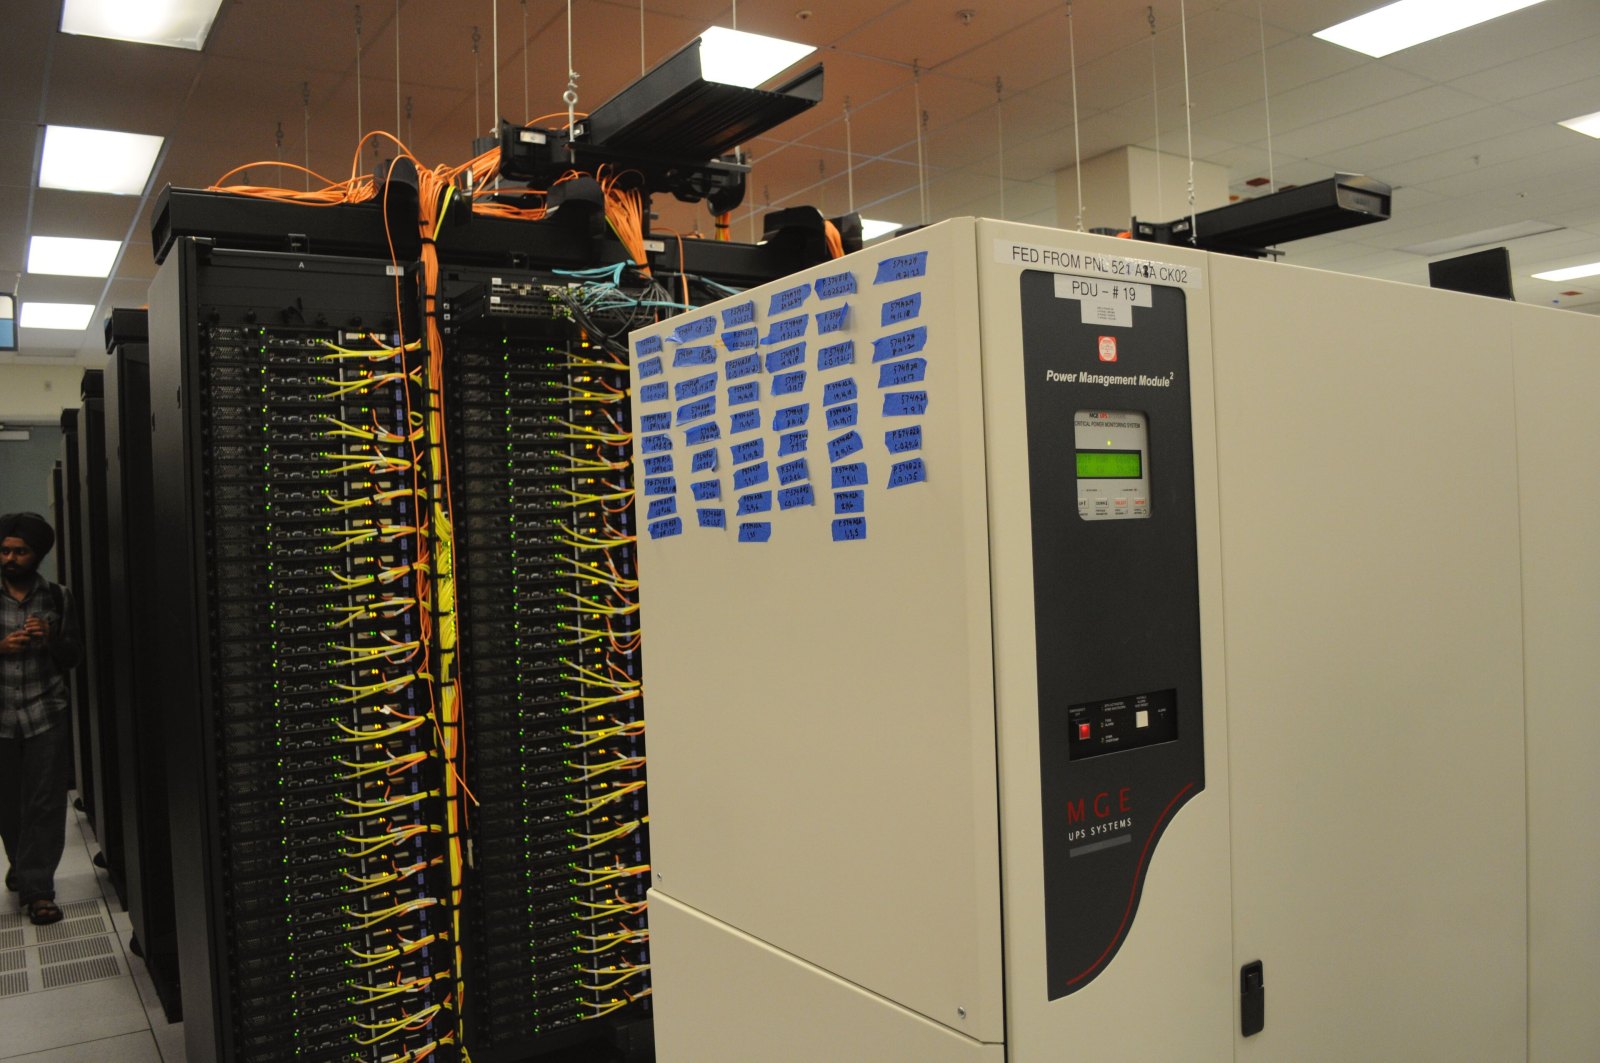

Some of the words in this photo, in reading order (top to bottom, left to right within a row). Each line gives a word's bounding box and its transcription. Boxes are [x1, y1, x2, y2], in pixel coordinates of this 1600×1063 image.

[1012, 246, 1039, 263] FED
[1043, 250, 1080, 269] FROM
[1084, 256, 1108, 272] PNL
[1112, 260, 1131, 276] 521
[1160, 267, 1188, 283] CK02
[1072, 280, 1098, 297] PDU
[1046, 370, 1078, 382] Power
[1079, 372, 1136, 386] Management
[1067, 786, 1133, 826] MGE
[1068, 829, 1086, 841] UPS
[1090, 817, 1132, 836] SYSTEMS
